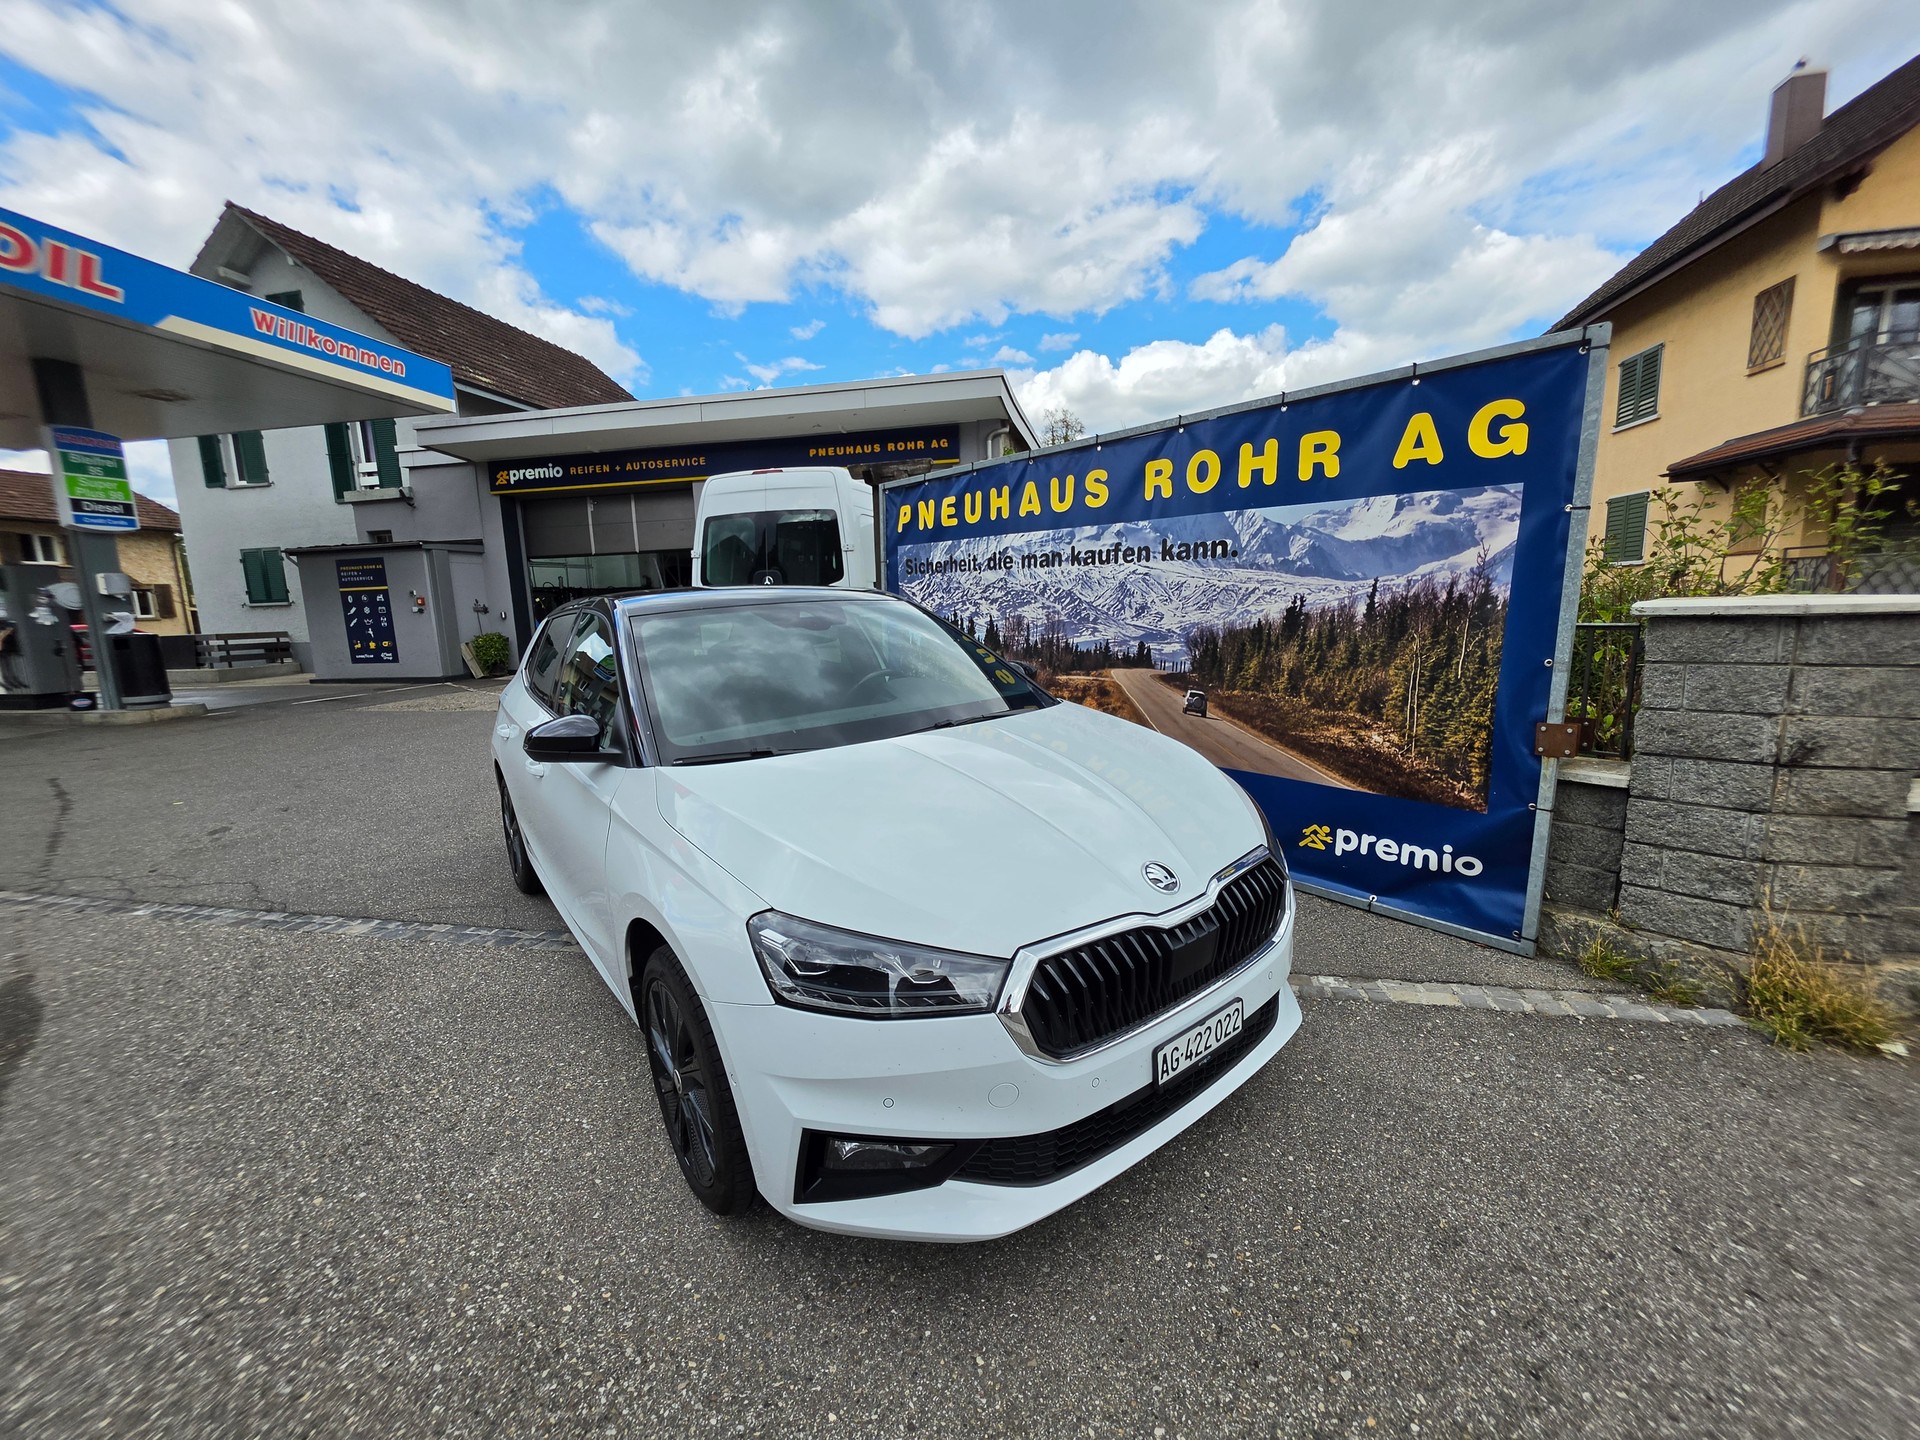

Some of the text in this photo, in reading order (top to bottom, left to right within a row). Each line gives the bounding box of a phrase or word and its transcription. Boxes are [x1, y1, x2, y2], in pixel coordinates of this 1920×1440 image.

[249, 306, 405, 377] Willkommen
[809, 439, 948, 457] PNEUHAUS ROHR AG
[510, 463, 563, 484] premio
[570, 464, 610, 475] REIFEN
[626, 457, 706, 471] AUTOSERVICE
[898, 398, 1529, 533] PNEUHAUS ROHR AG
[81, 501, 124, 514] Diesel
[906, 538, 1238, 575] Sicherheit, die man kaufen kann.
[1335, 828, 1483, 876] premio
